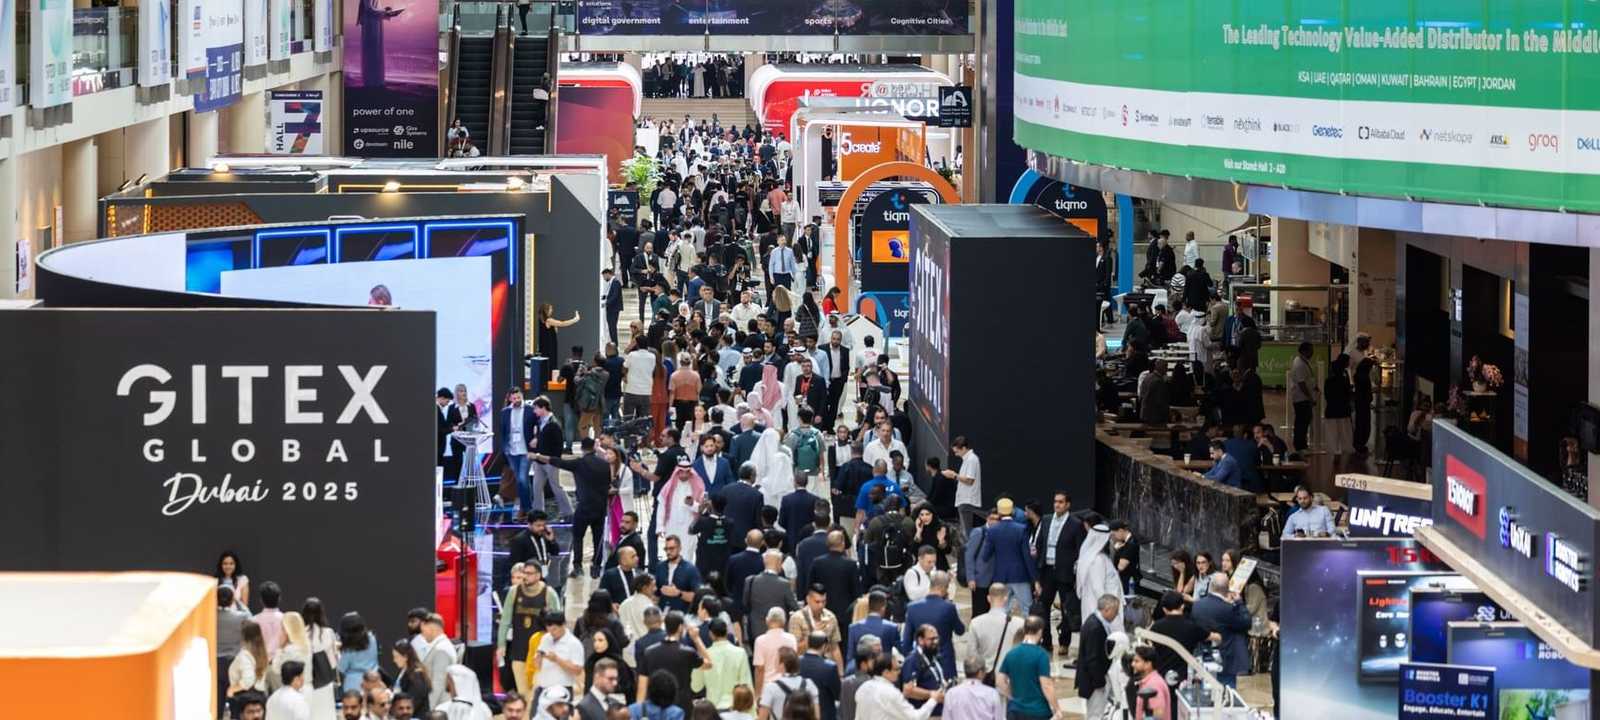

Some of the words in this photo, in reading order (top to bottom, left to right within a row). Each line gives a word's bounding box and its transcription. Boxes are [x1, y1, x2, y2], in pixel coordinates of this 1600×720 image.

[582, 17, 610, 25] digital
[611, 17, 661, 25] government
[689, 17, 749, 25] entertainment
[804, 17, 832, 26] sports
[890, 17, 926, 26] Cognitive
[927, 17, 950, 25] Cities
[1222, 24, 1240, 44] The
[1241, 24, 1280, 50] Leading
[1281, 25, 1343, 52] Technology
[1344, 26, 1424, 49] Value-Added
[1427, 27, 1502, 50] Distributor
[1506, 28, 1520, 51] in
[1523, 28, 1549, 52] the
[1552, 29, 1600, 53] Middl
[1313, 72, 1326, 84] UAE
[1330, 72, 1351, 86] QATAR
[1355, 72, 1377, 86] OMAN
[1381, 74, 1409, 87] KUWAIT
[1413, 74, 1448, 87] BAHRAIN
[1453, 75, 1477, 88] EGYPT
[1482, 76, 1516, 90] JORDAN
[353, 107, 383, 117] power
[384, 107, 395, 116] of
[396, 108, 415, 116] one
[284, 101, 321, 153] 7
[1312, 124, 1343, 139] Genetec
[276, 123, 284, 151] HALL
[393, 139, 414, 150] nile
[1528, 133, 1558, 153] groq
[1055, 199, 1088, 211] tiqmo
[883, 210, 910, 223] tiqm
[894, 307, 910, 320] tiq
[116, 363, 390, 426] GITEX
[142, 438, 390, 463] GLOBAL
[162, 471, 269, 516] Dubai
[282, 482, 358, 501] 2025
[1404, 688, 1466, 707] Booster
[1470, 692, 1489, 709] K1
